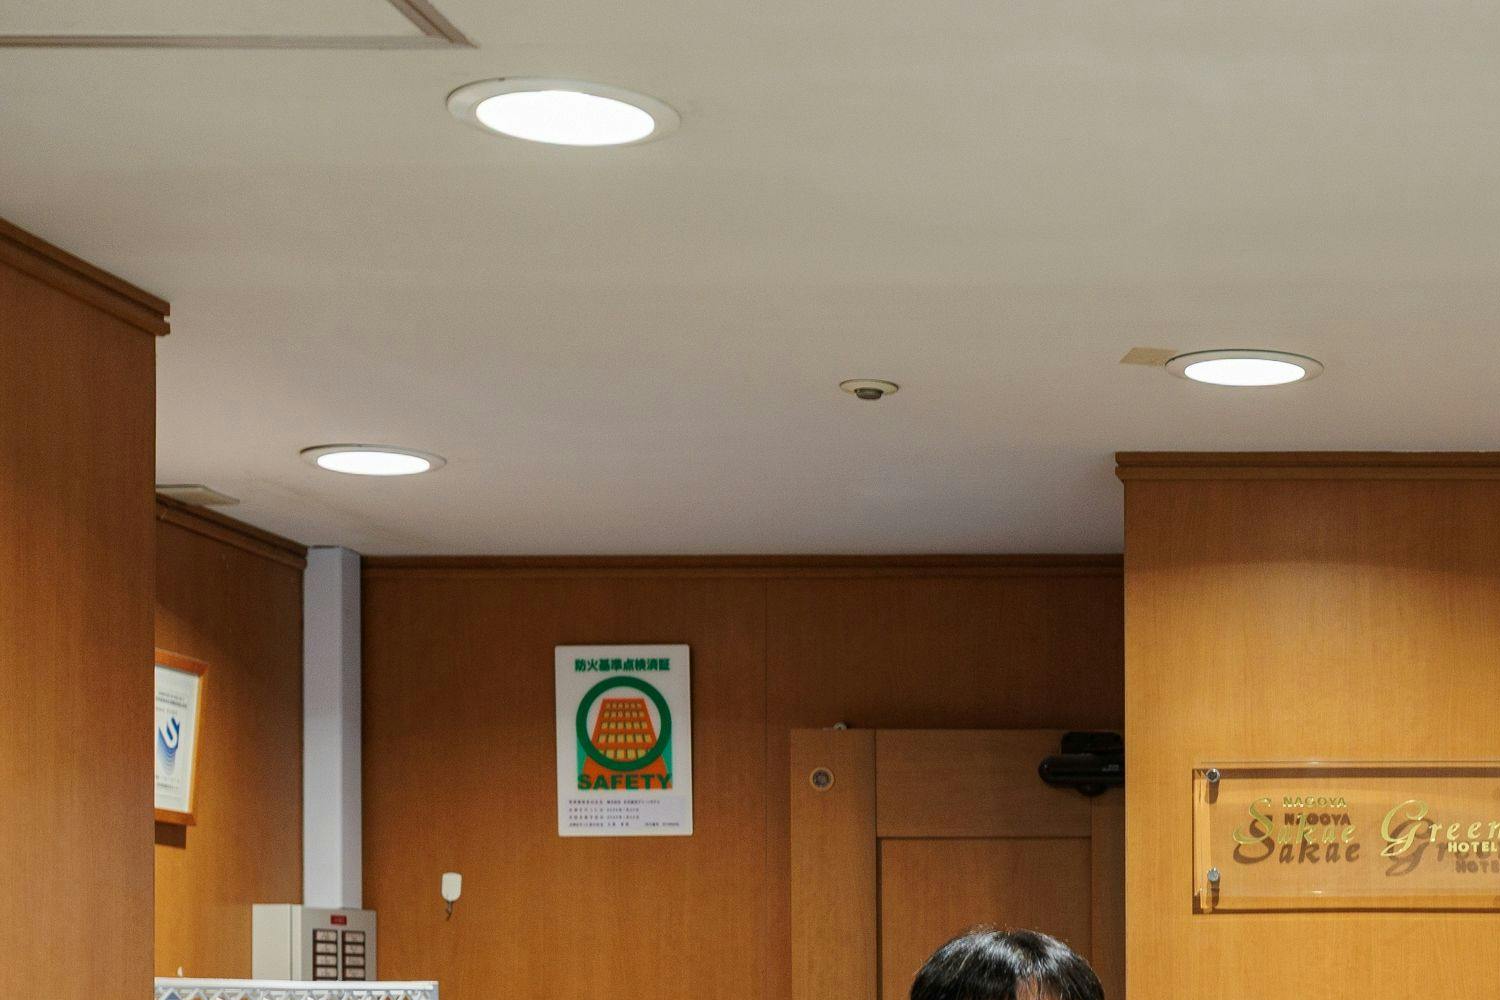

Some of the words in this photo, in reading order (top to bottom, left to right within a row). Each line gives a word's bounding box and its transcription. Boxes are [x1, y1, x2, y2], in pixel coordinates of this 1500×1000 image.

[575, 658, 671, 671] 防火基準点検済証
[577, 774, 672, 789] SAFETY
[1282, 796, 1348, 809] NAGOYA
[1233, 796, 1358, 846] Sakae
[1447, 841, 1499, 854] HOTEL
